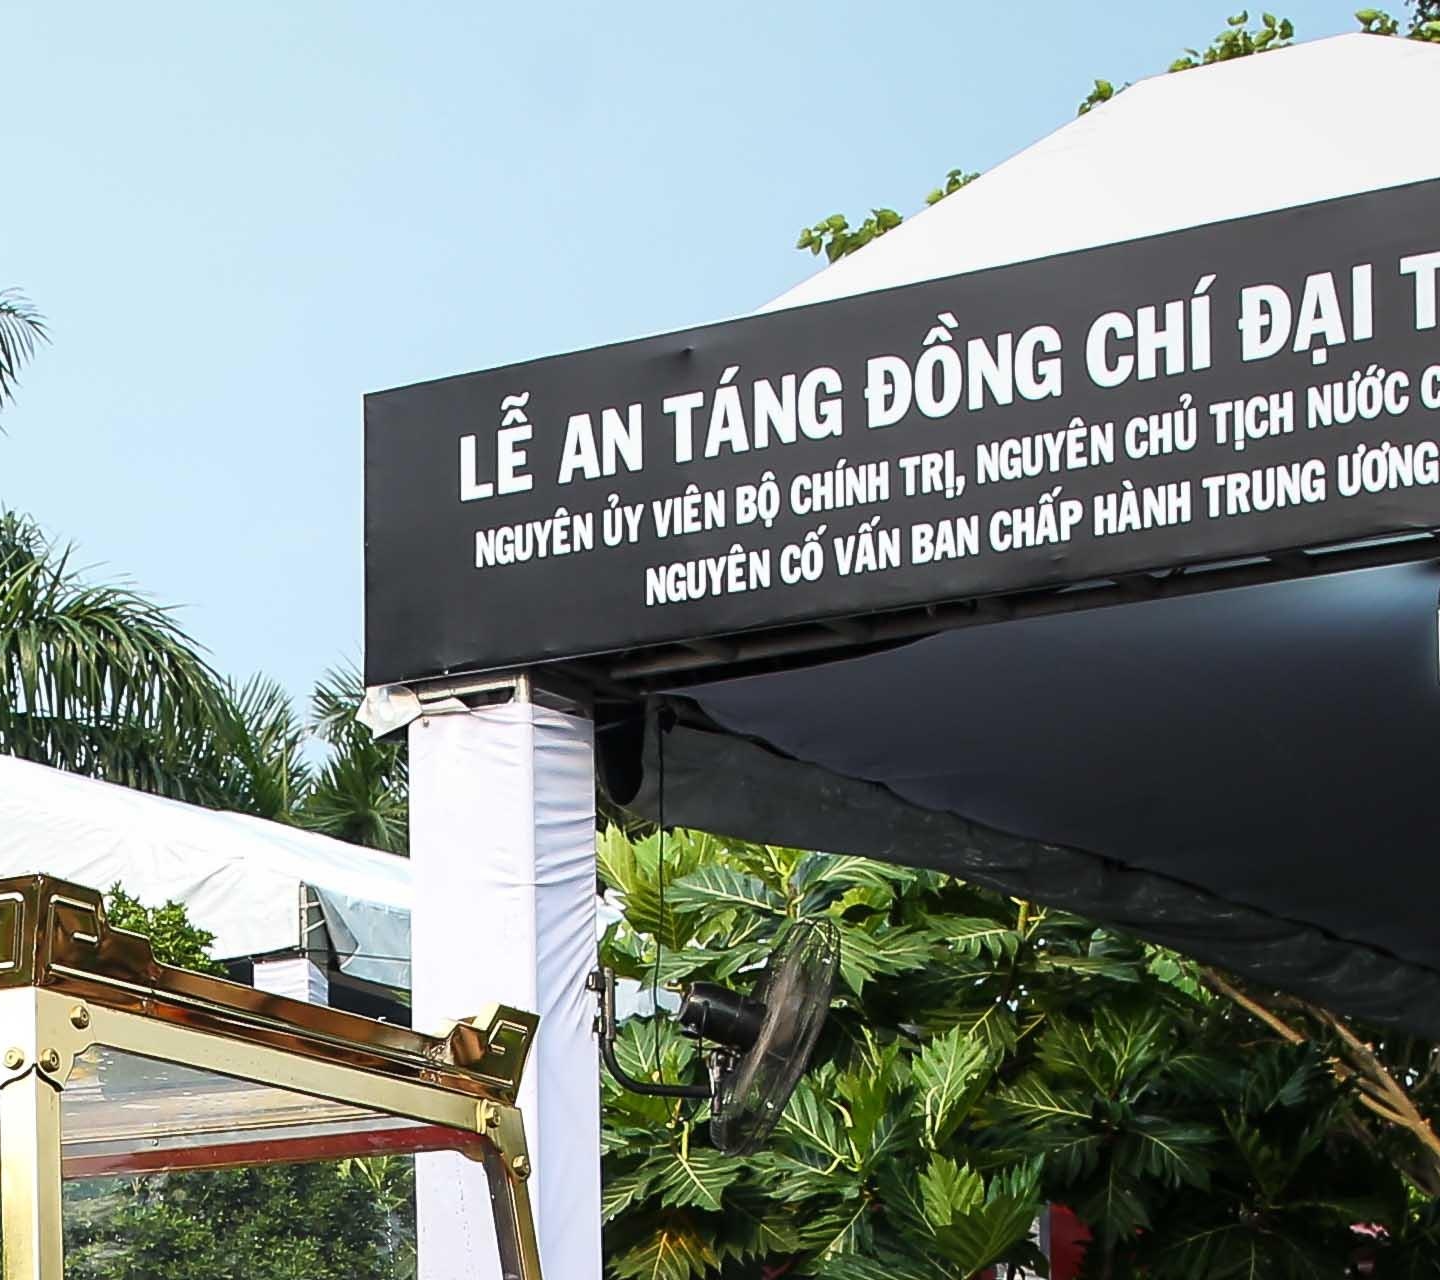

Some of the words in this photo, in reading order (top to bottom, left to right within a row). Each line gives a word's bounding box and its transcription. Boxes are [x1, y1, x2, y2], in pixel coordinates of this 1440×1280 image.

[460, 391, 533, 502] LỄ
[558, 403, 643, 484] AN
[663, 365, 843, 463] TÁNG
[864, 312, 1062, 429] ĐỒNG
[1086, 274, 1217, 387] CHÍ
[1238, 263, 1373, 365] ĐẠI
[475, 507, 594, 568] NGUYÊN
[603, 493, 645, 546] ỦY
[652, 484, 726, 538] VIÊN
[735, 470, 780, 528] BỘ
[790, 458, 890, 515] CHÍNH
[899, 449, 966, 499] TRỊ,
[976, 416, 1114, 484] NGUYÊN
[1124, 393, 1197, 459] CHỦ
[1209, 390, 1294, 451] TỊCH
[1307, 364, 1410, 429] NƯỚC
[646, 543, 771, 606] NGUYÊN
[780, 525, 828, 584] CỐ
[833, 515, 901, 576] VẤN
[911, 515, 979, 564] BAN
[989, 485, 1083, 552] CHẤP
[1093, 479, 1191, 536] HÀNH
[1201, 459, 1326, 518] TRUNG
[1337, 441, 1439, 497] ƯƠNG
